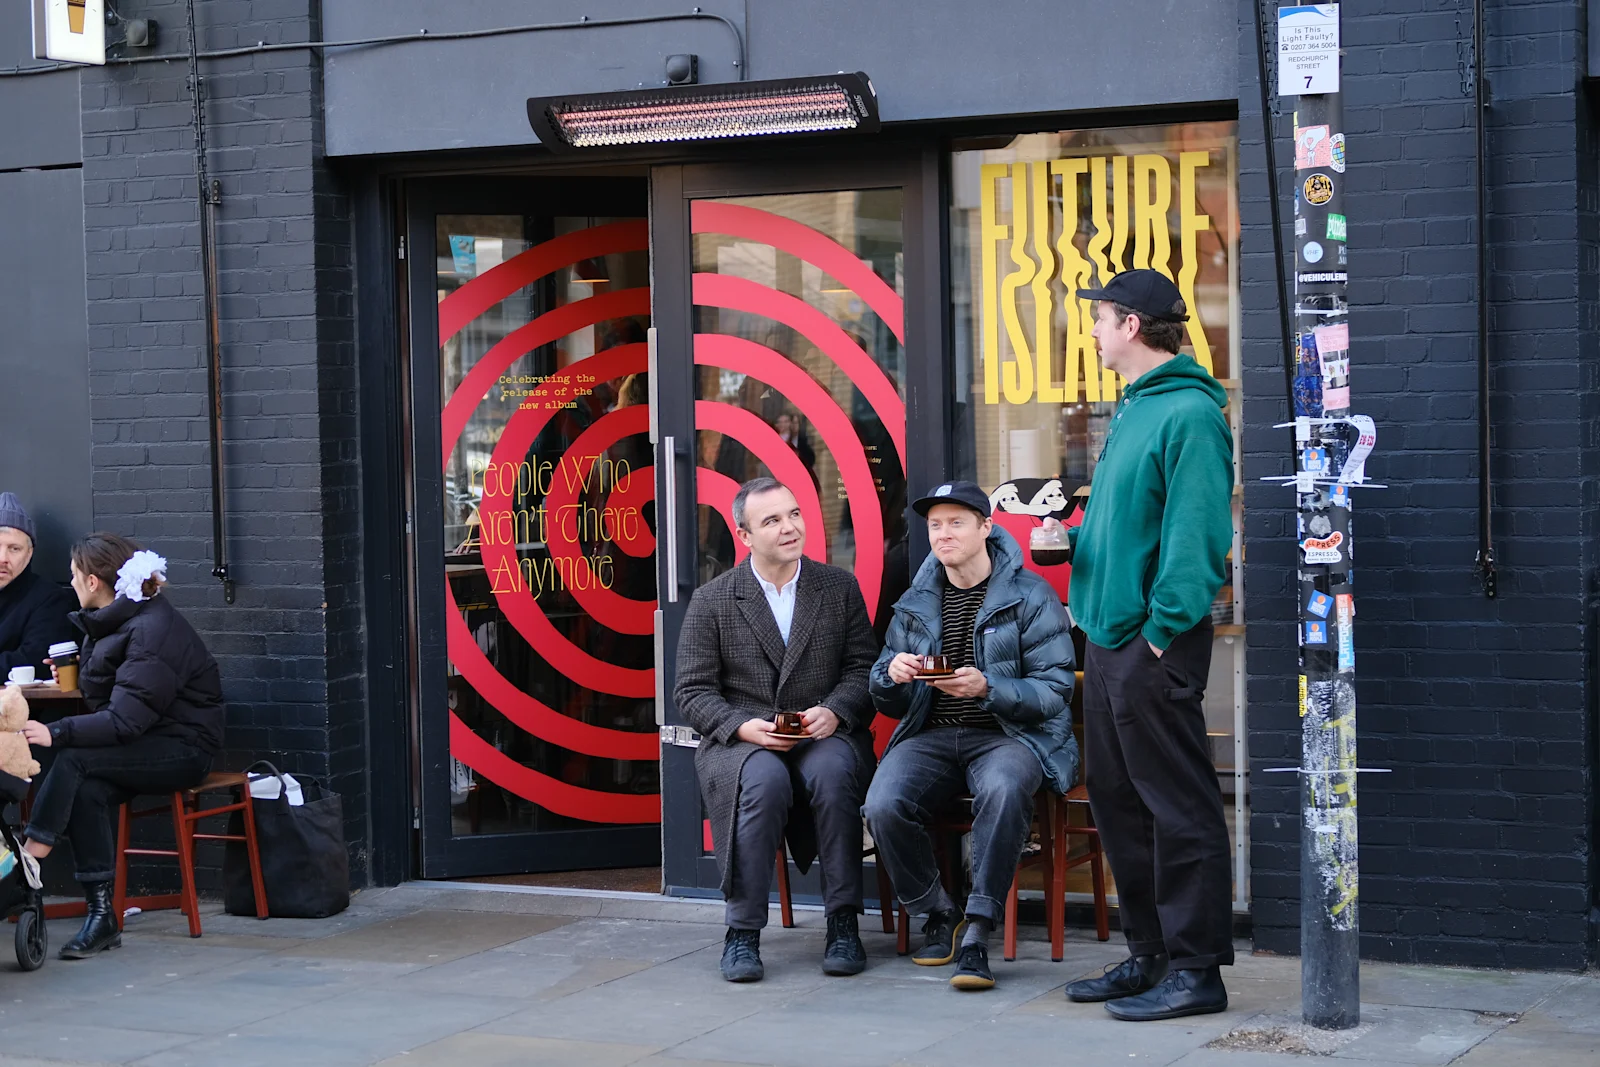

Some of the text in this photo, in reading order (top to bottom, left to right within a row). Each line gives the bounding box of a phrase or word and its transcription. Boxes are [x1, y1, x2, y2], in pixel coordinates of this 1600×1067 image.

[1282, 33, 1334, 43] Light Faulty?
[1288, 55, 1329, 63] REDCHURCH
[1304, 76, 1313, 89] 7
[981, 151, 1211, 272] FUTURE
[981, 268, 1215, 405] ISLA
[499, 374, 596, 385] Celebrating the
[502, 387, 593, 397] release of the
[519, 401, 578, 410] new album
[471, 453, 631, 505] People Who
[463, 501, 639, 546] Aren't There
[490, 554, 614, 601] Anymore
